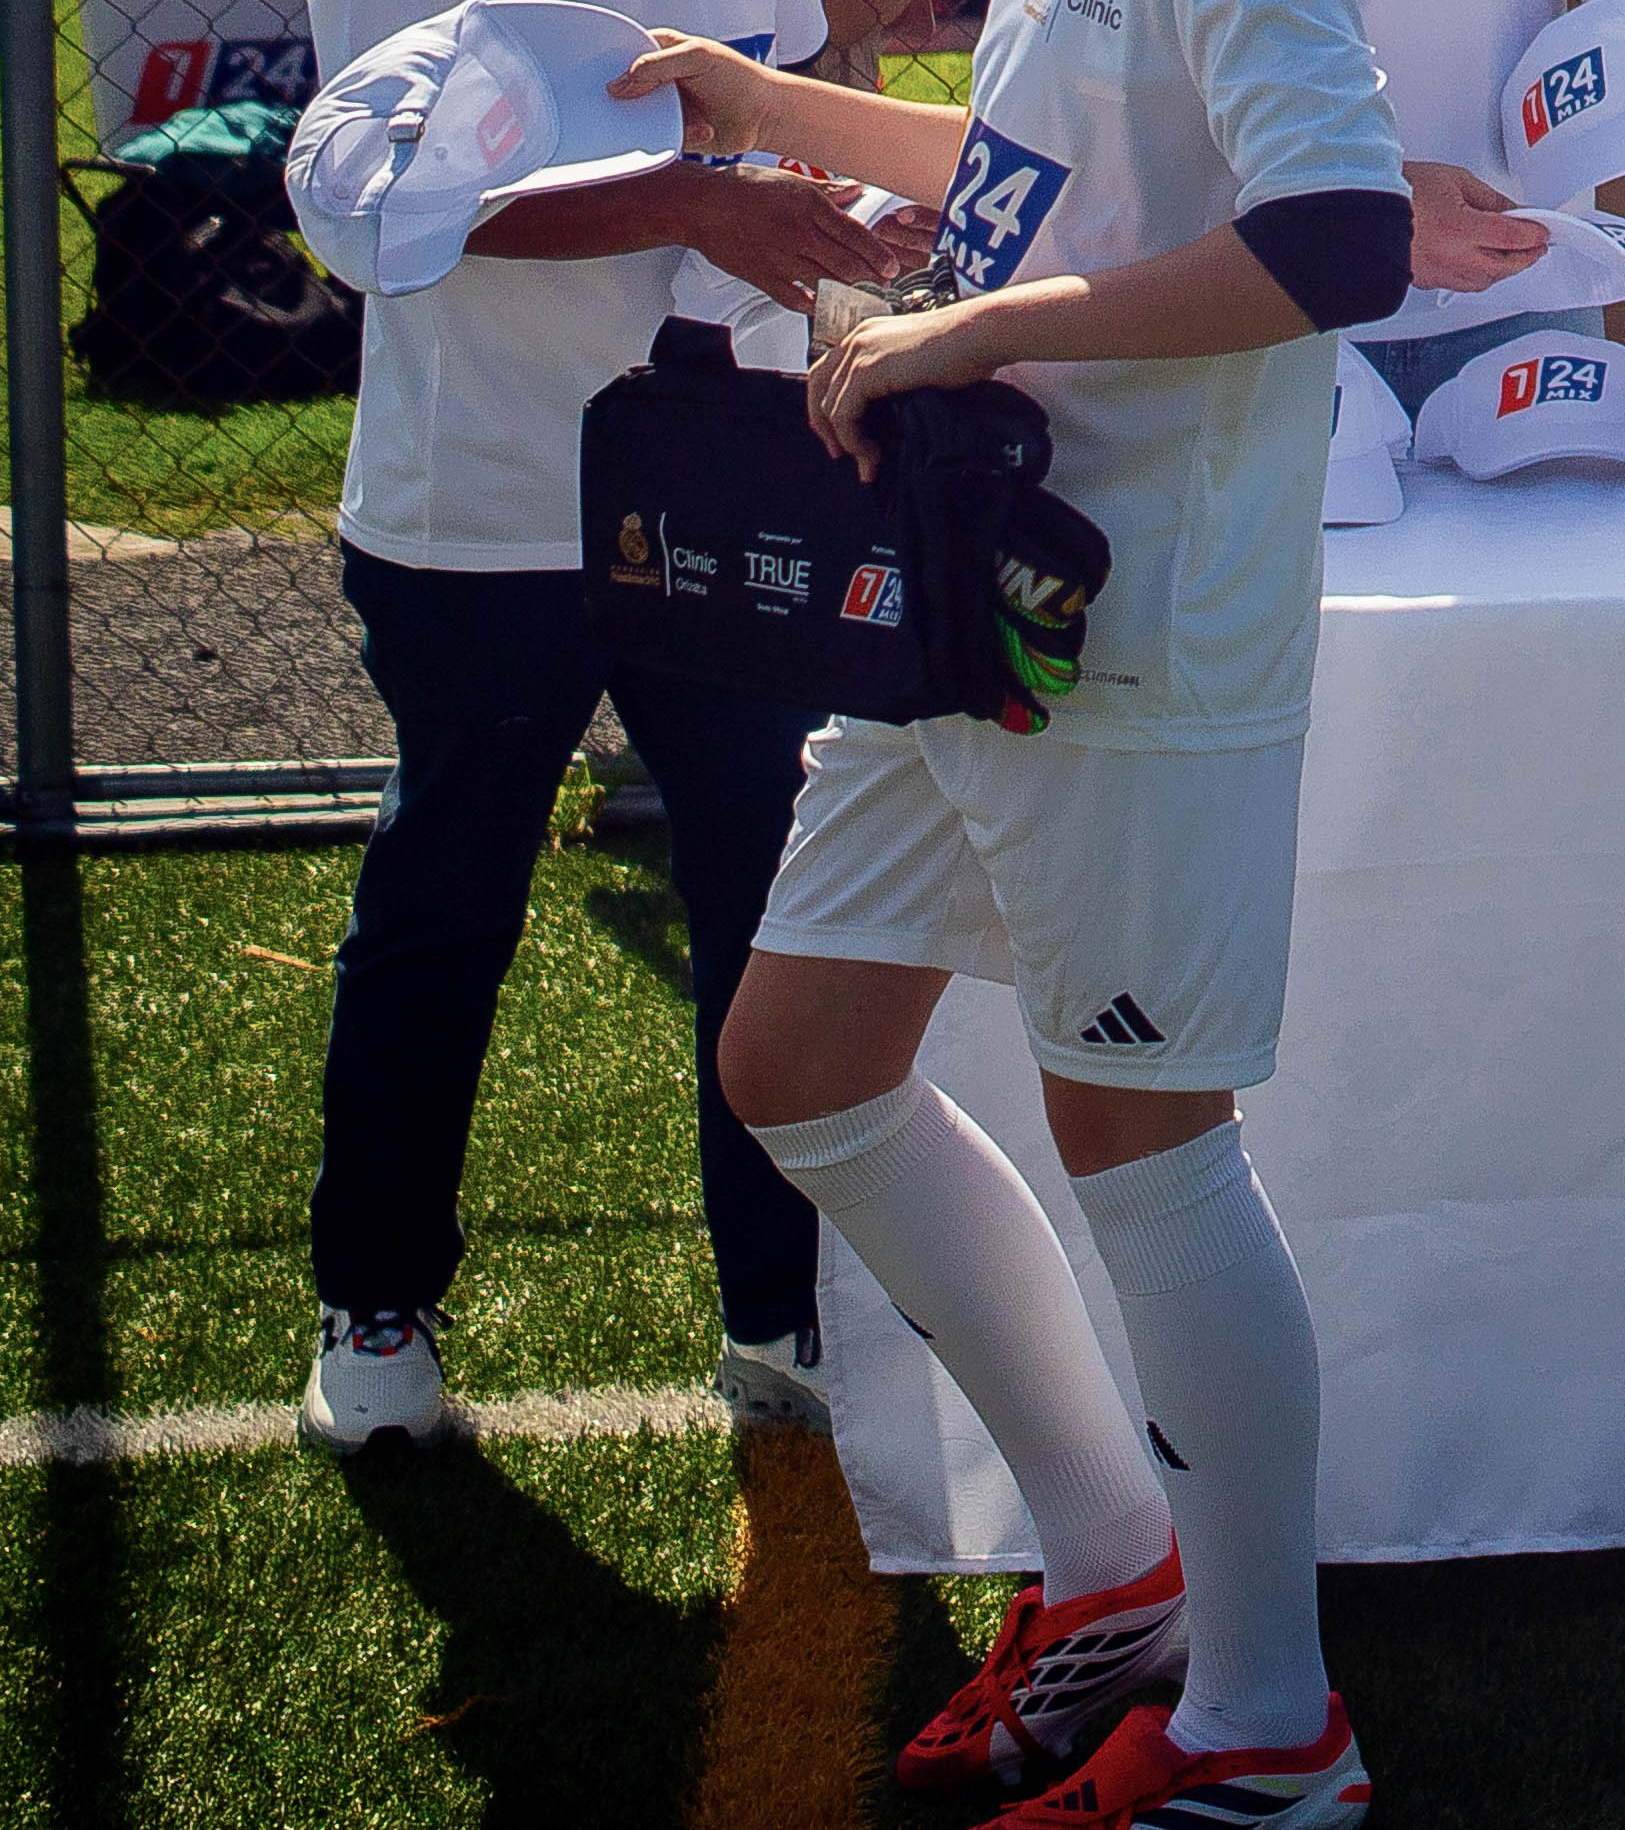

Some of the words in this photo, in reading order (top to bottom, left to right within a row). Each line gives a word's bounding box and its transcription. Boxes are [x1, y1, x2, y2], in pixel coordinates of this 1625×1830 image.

[1549, 56, 1598, 108] 24
[1557, 91, 1598, 122] MIX
[949, 140, 1041, 249] 24
[1547, 360, 1598, 389] 24
[1545, 389, 1593, 400] MIX
[673, 547, 718, 575] Clinic
[744, 552, 812, 589] TRUE
[862, 570, 877, 603] 7
